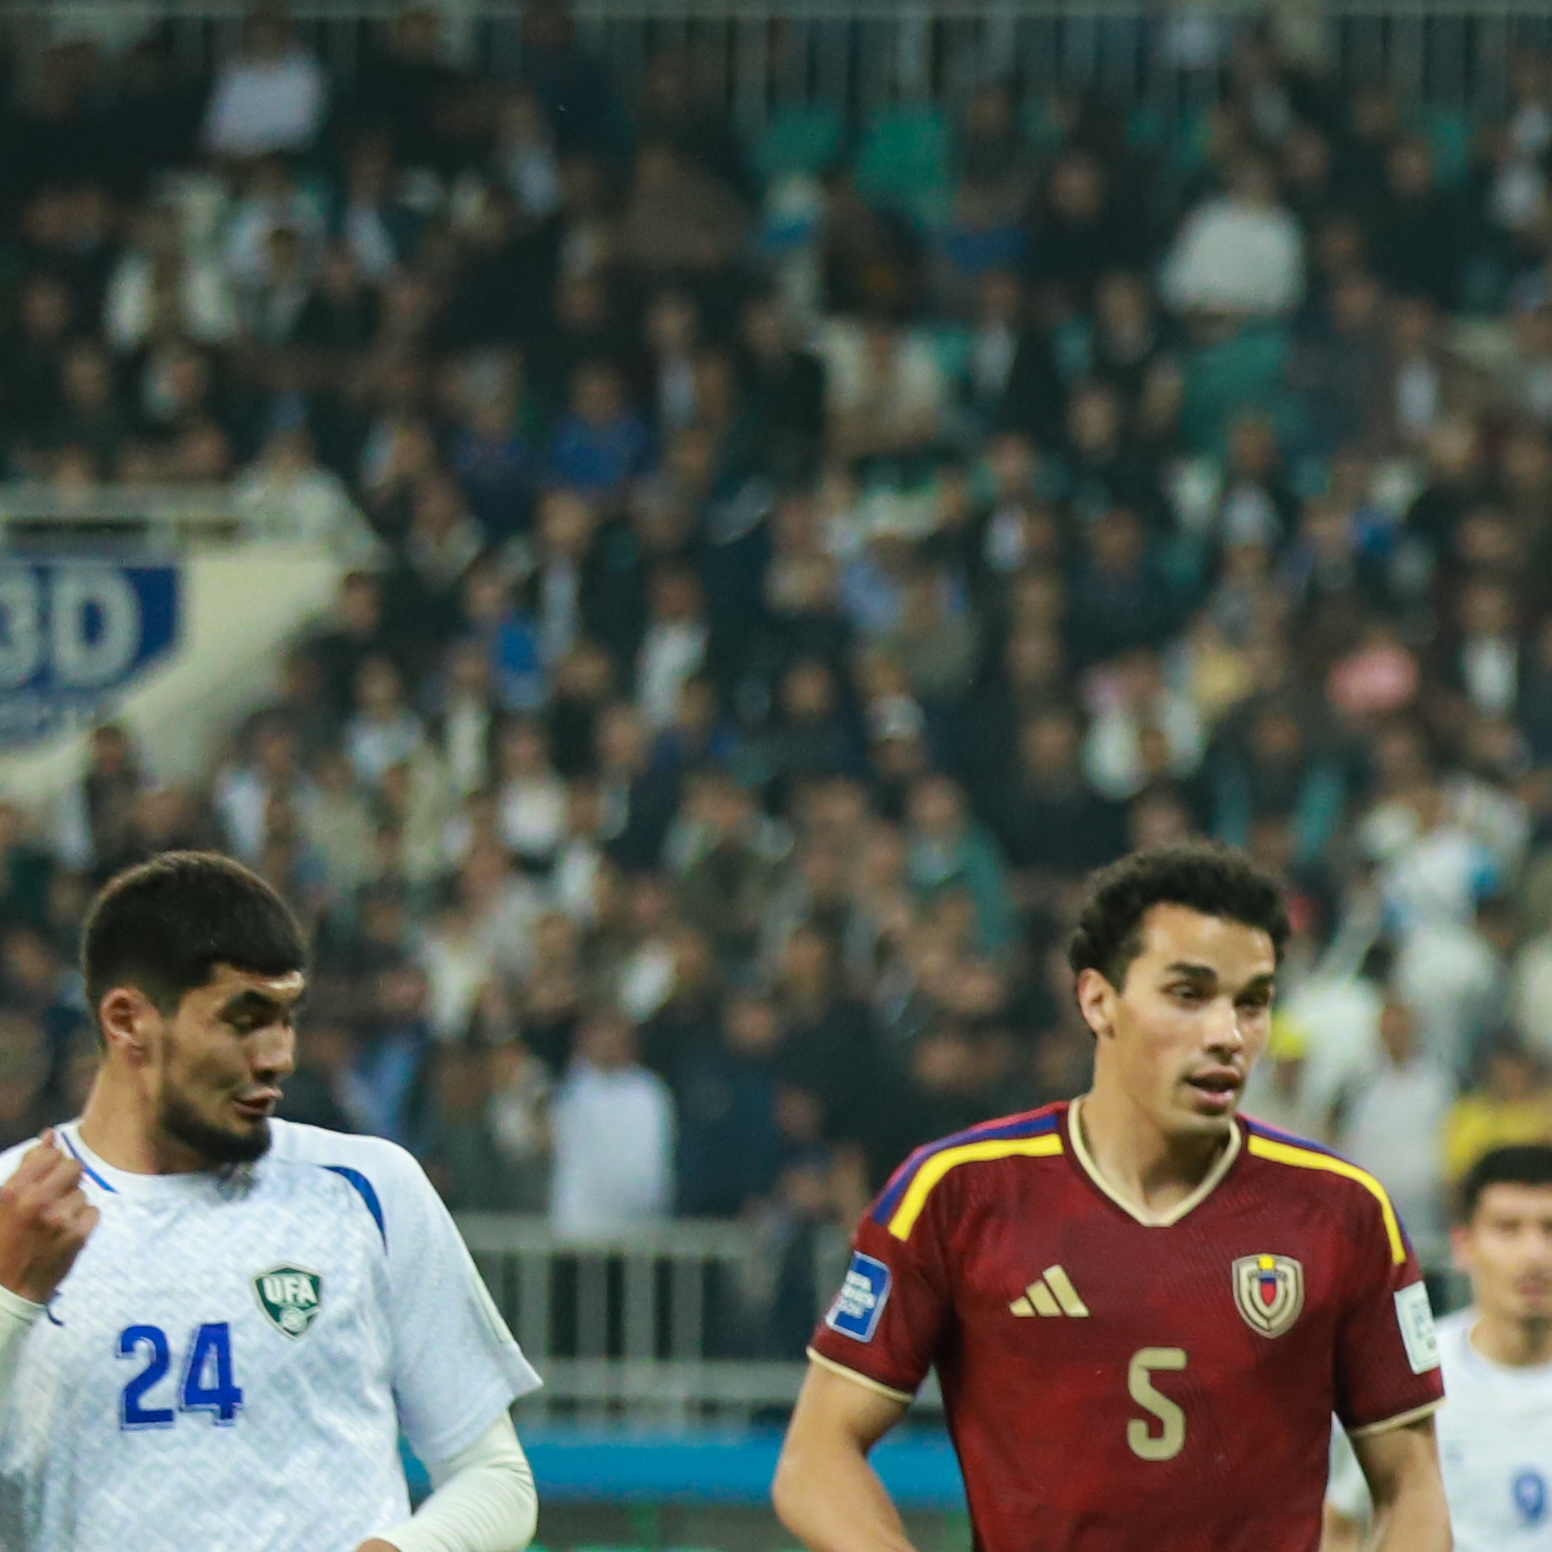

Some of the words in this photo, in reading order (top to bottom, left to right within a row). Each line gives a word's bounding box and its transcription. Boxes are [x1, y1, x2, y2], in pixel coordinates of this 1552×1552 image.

[263, 1273, 318, 1306] UFA
[115, 1323, 243, 1430] 24
[1128, 1347, 1187, 1461] 5
[1512, 1469, 1547, 1526] 9
